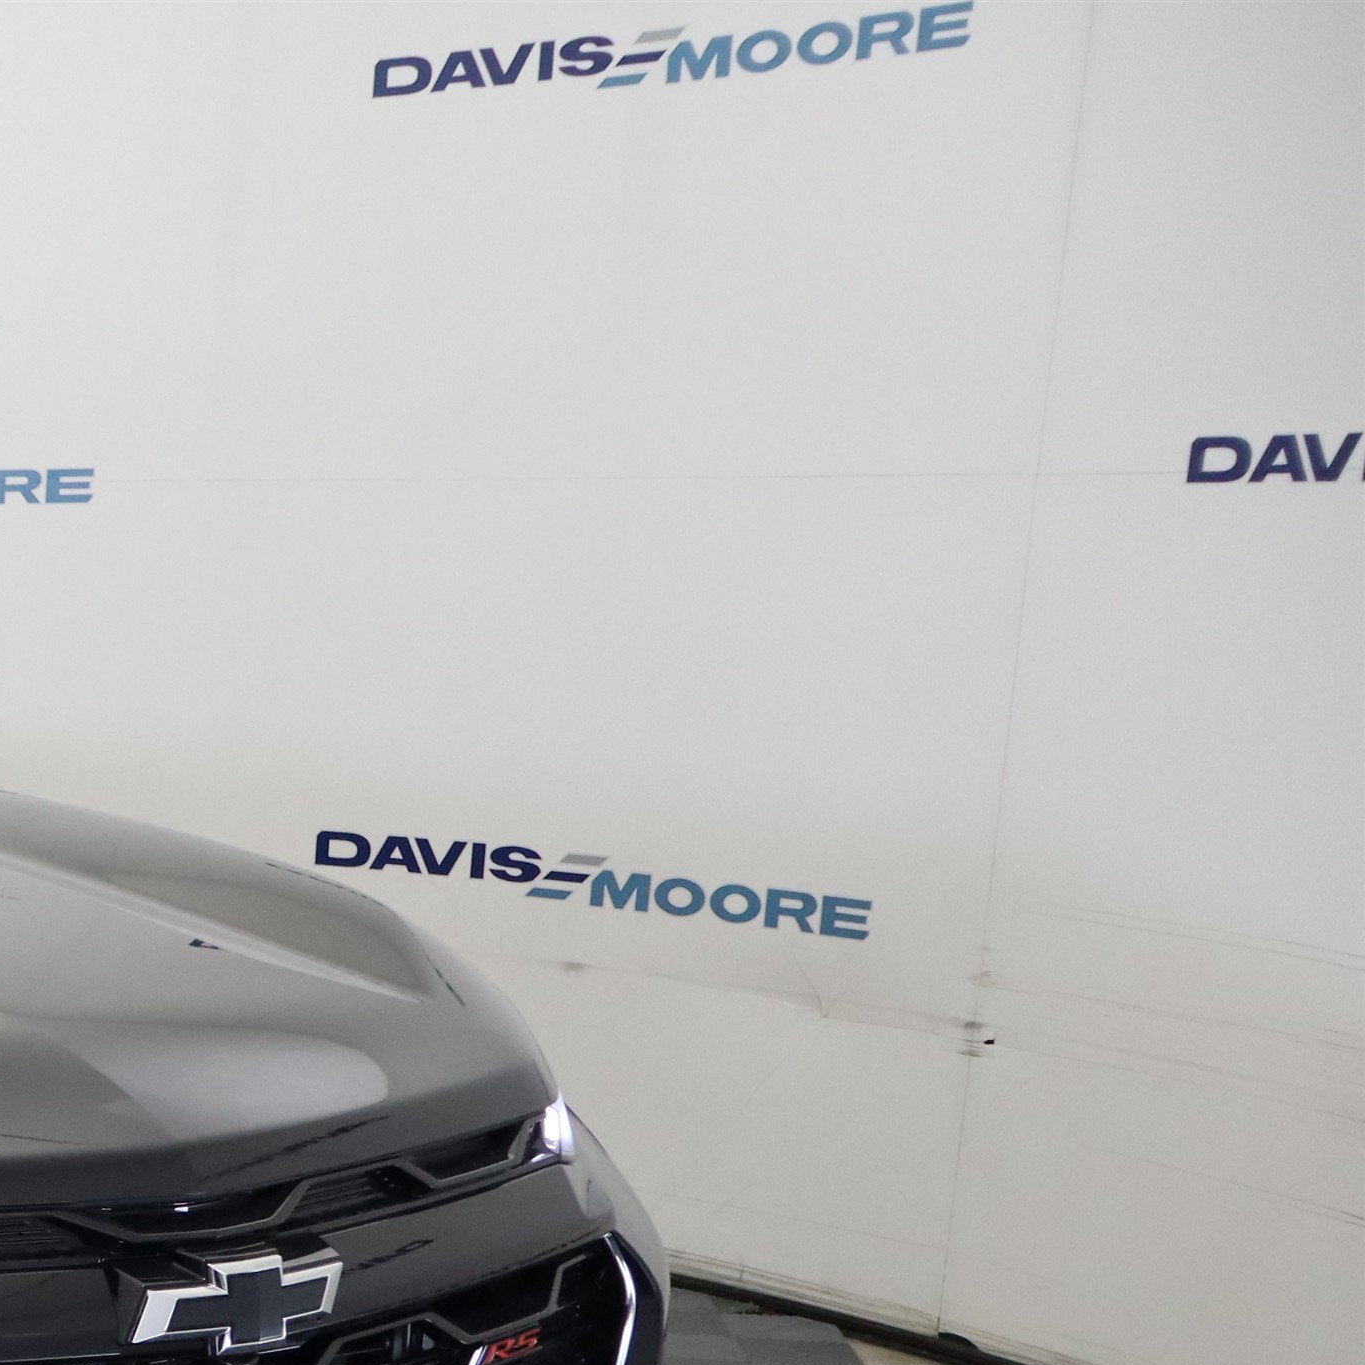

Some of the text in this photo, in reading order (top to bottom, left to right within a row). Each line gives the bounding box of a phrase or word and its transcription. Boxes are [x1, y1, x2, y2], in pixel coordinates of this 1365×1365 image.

[372, 0, 973, 98] DAVIS MOORE
[1186, 432, 1365, 483] DAV
[314, 830, 872, 941] DAVIS MOORE
[482, 1327, 542, 1365] RS
